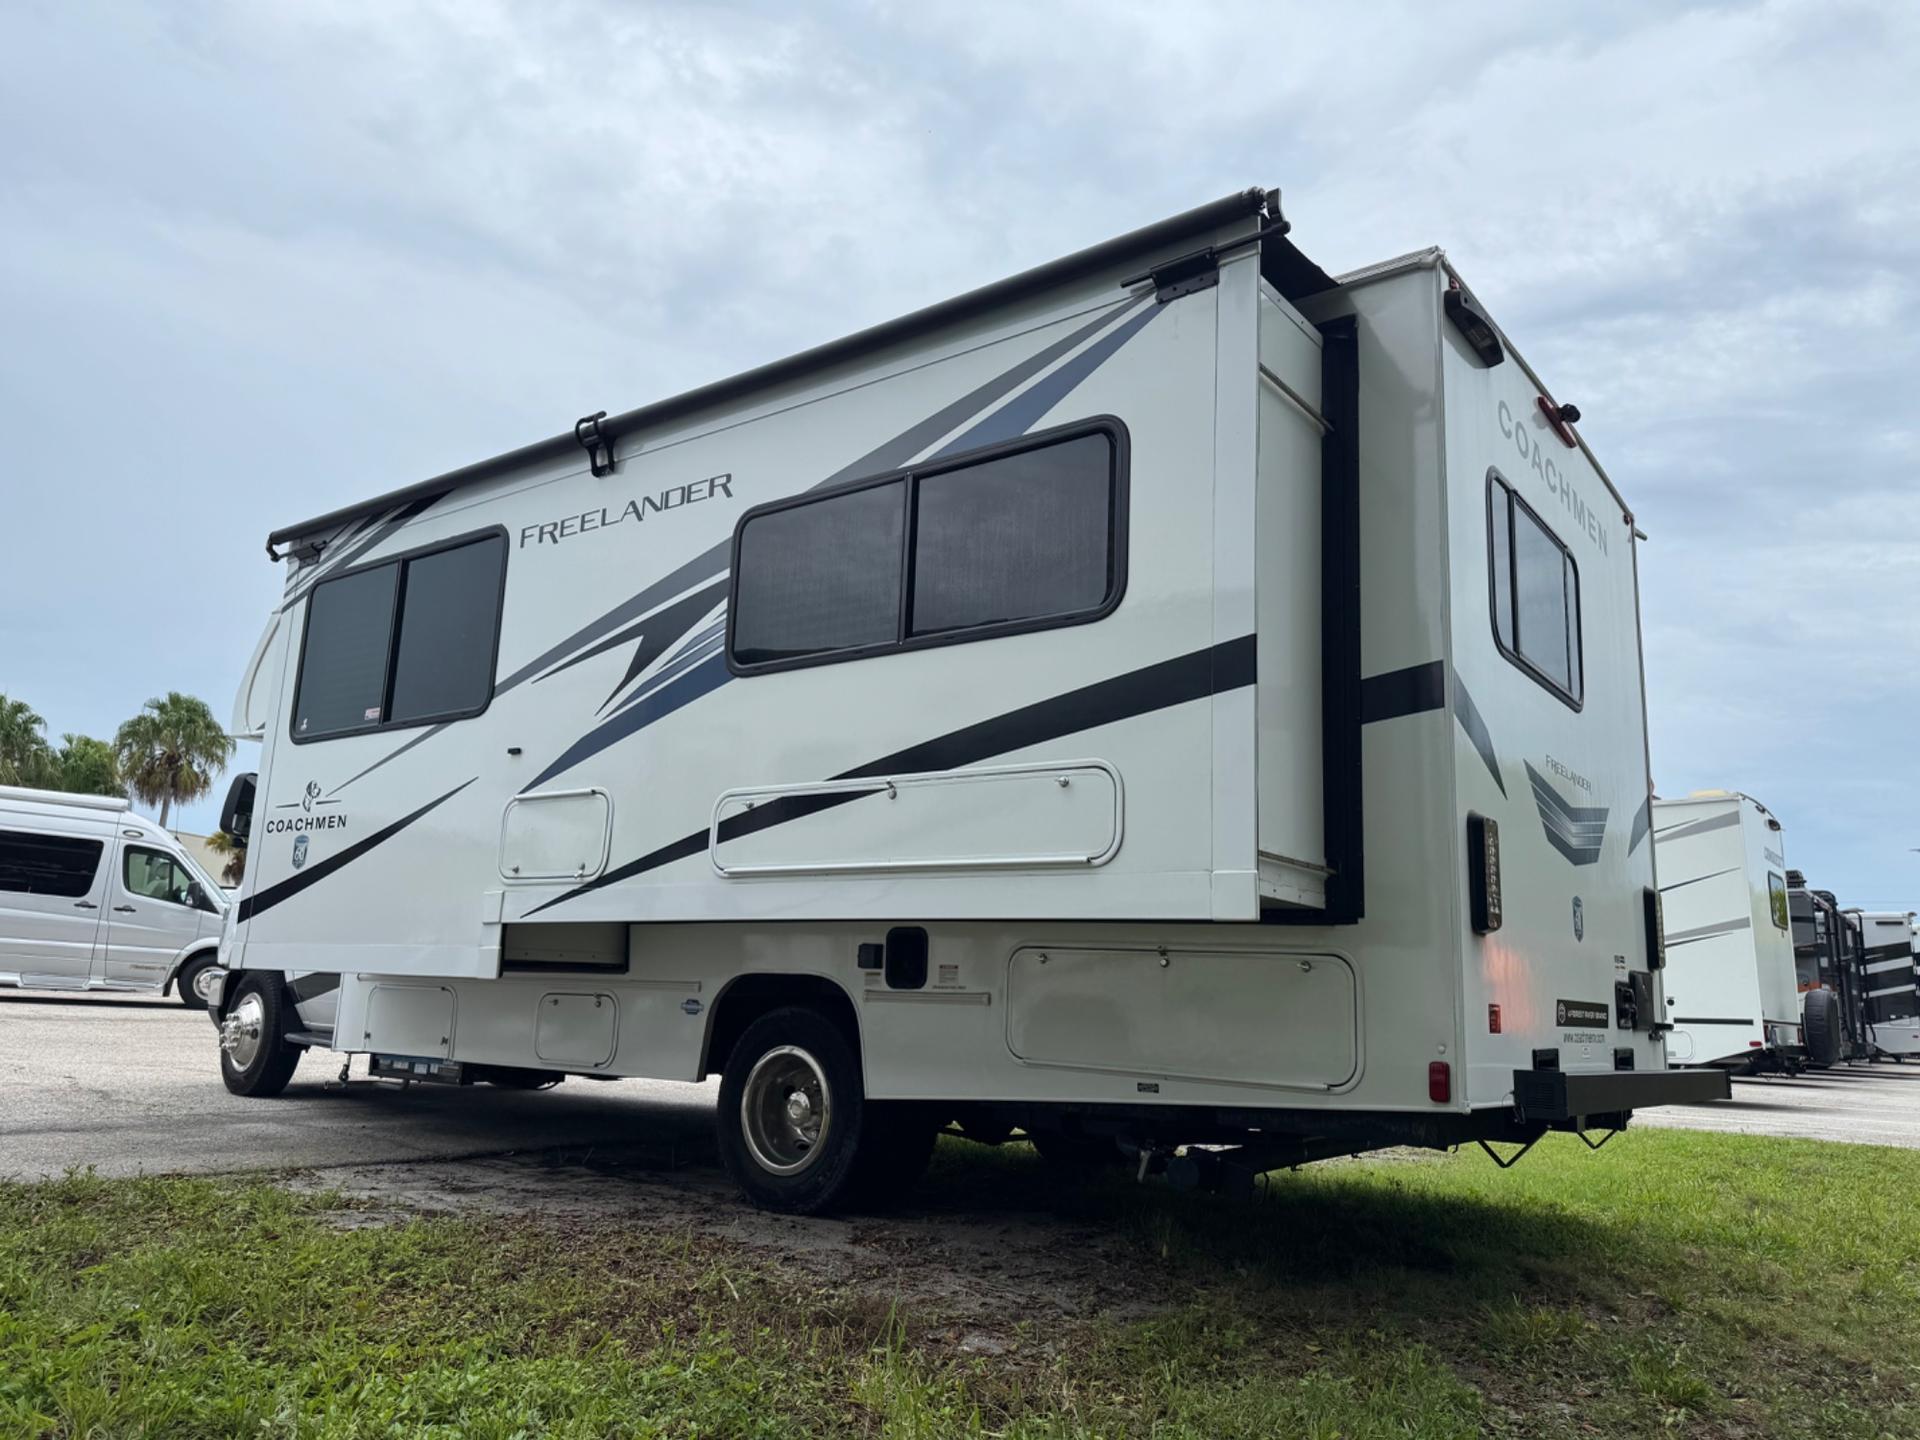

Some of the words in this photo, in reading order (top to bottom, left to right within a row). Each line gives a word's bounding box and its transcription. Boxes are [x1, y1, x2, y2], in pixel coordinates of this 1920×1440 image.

[1497, 399, 1608, 557] COACHMEN
[519, 472, 734, 549] FREELANDER
[1545, 753, 1593, 792] FREELANDER
[266, 814, 347, 834] COACHMEN
